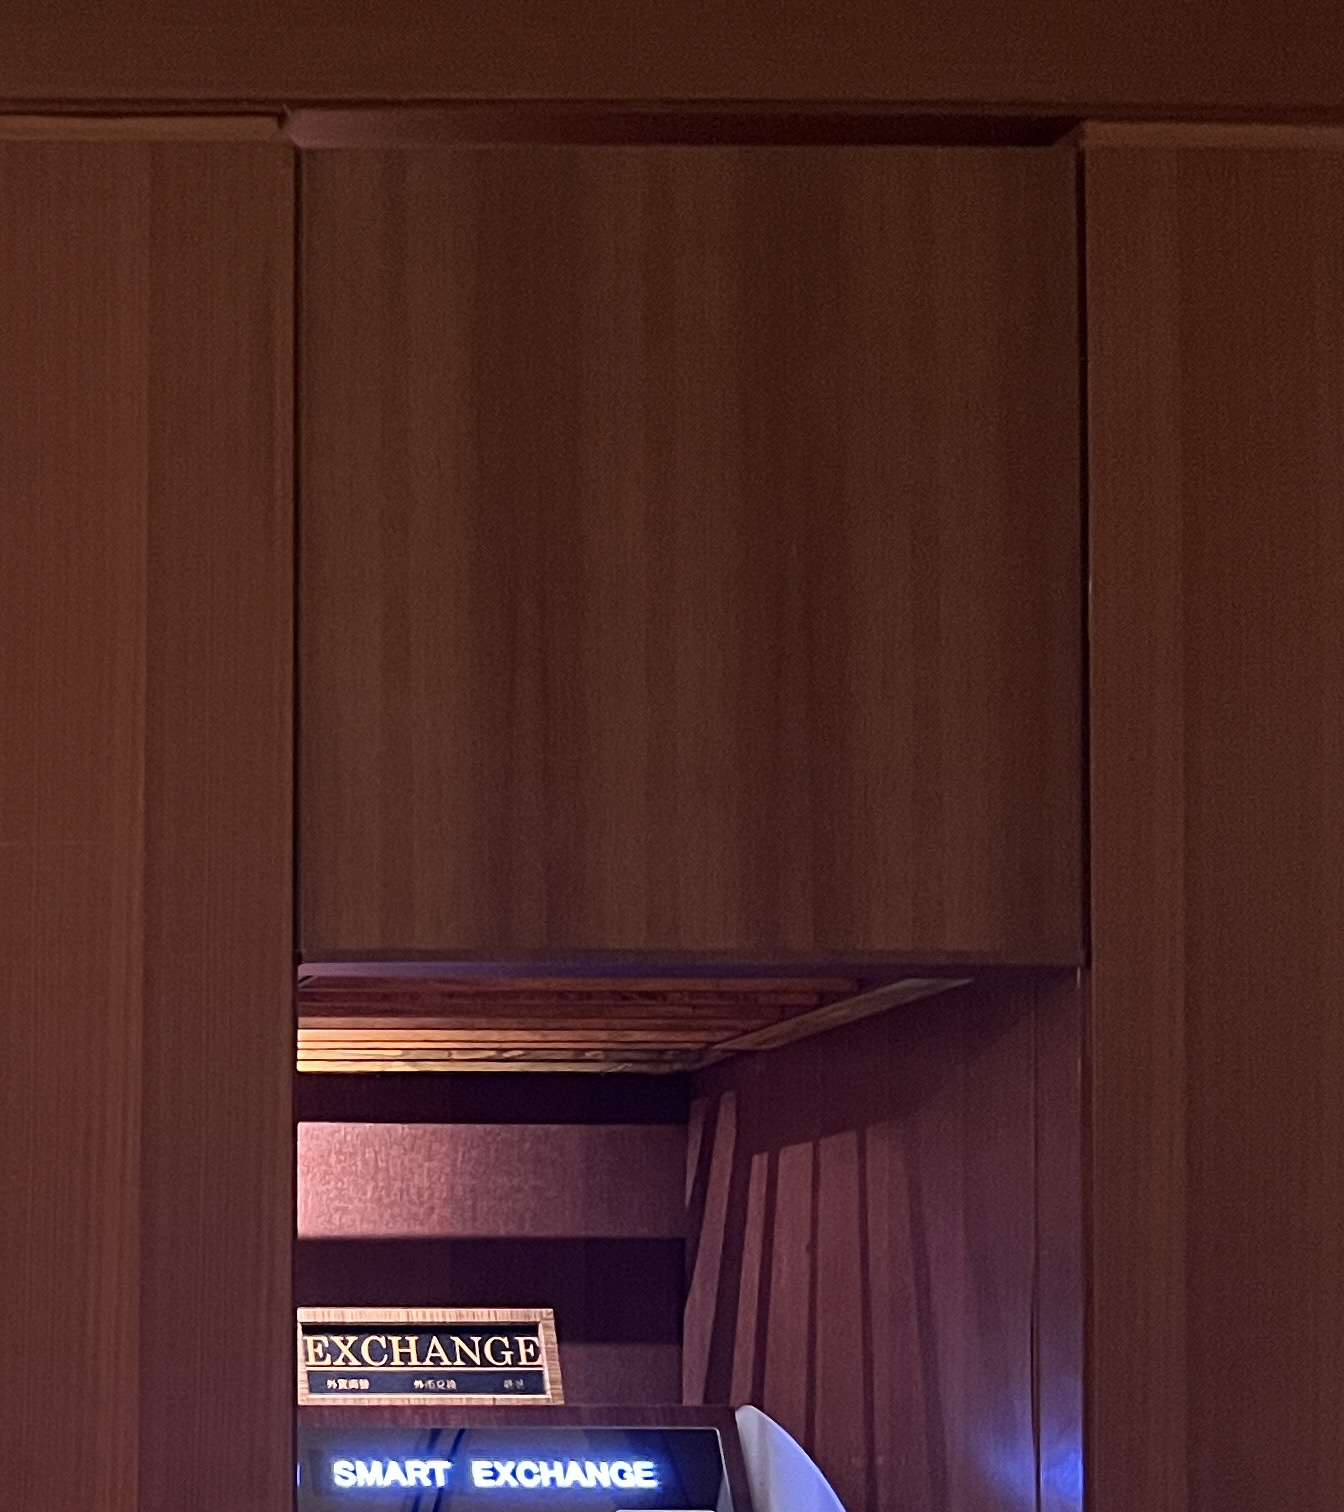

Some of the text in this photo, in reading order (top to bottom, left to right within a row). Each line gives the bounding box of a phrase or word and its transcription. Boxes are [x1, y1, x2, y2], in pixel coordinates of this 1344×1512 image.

[303, 1335, 543, 1366] EXCHANGE
[333, 1460, 659, 1487] SMART EXCHANGE
